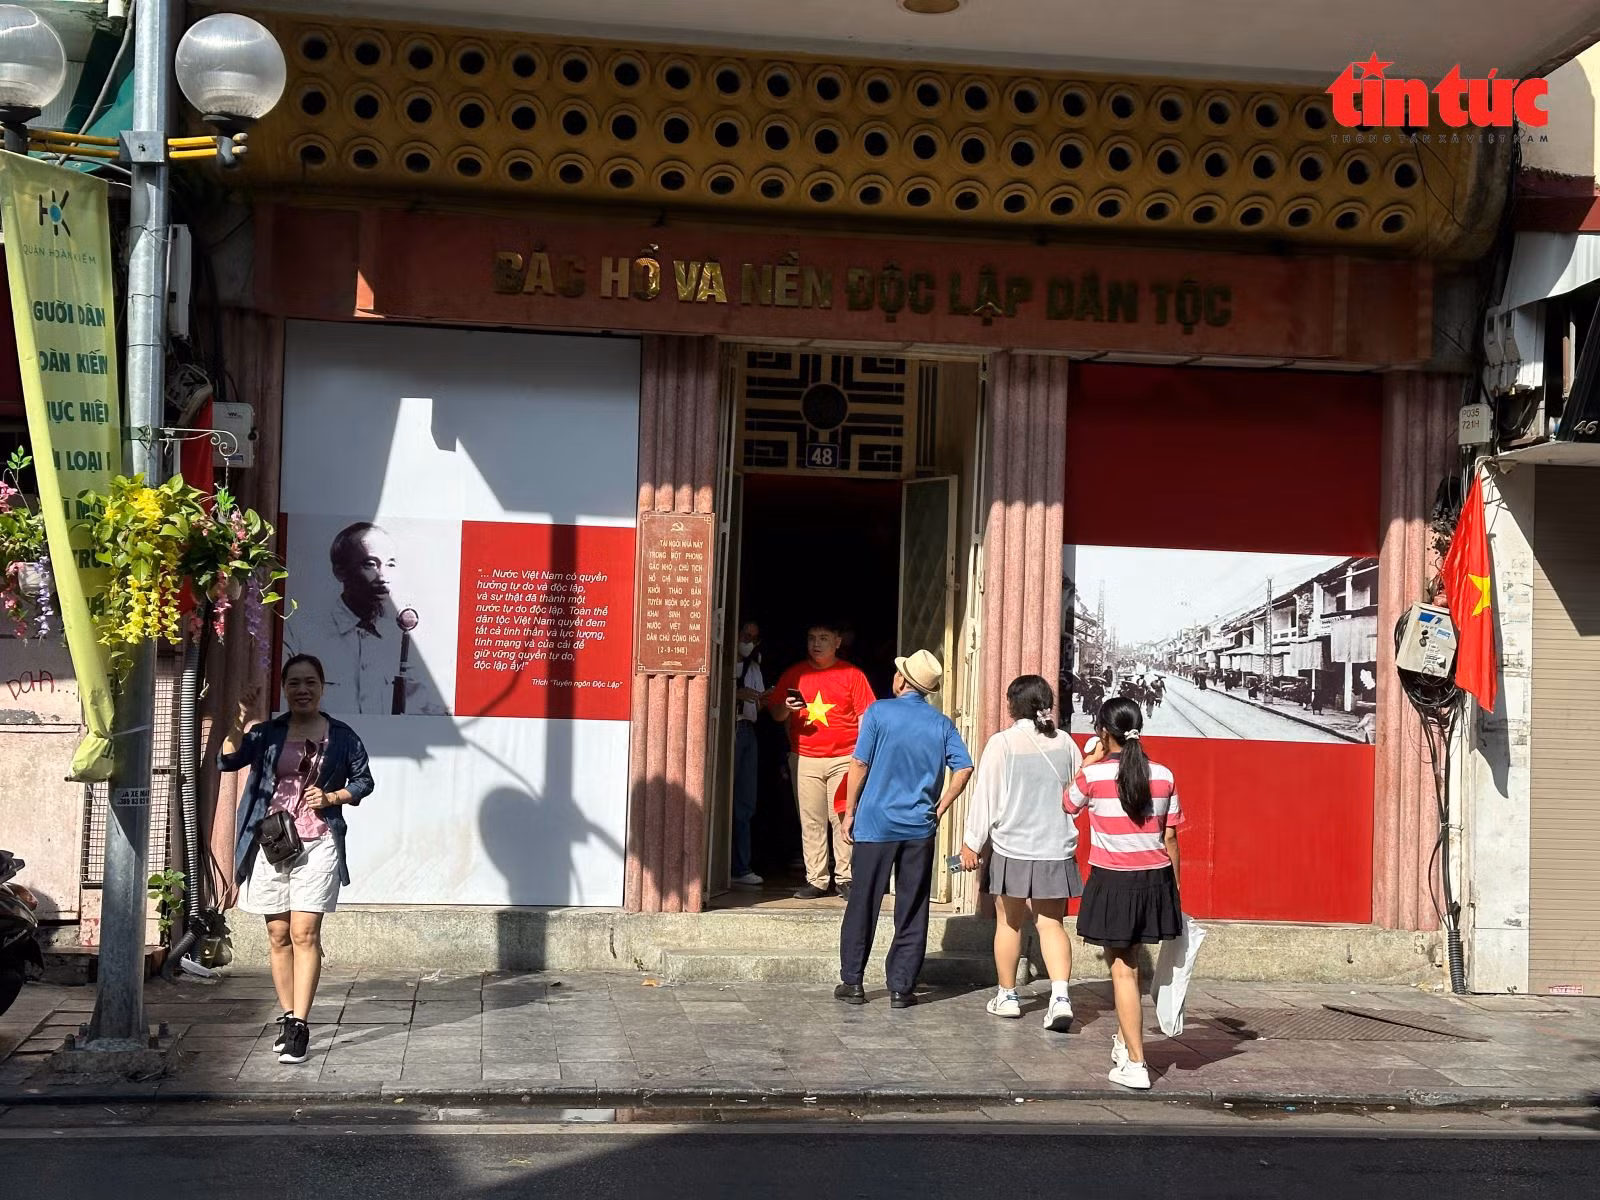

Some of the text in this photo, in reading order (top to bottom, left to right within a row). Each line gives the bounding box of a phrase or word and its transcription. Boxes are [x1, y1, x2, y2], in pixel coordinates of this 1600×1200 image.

[494, 242, 586, 297] BÁC
[600, 242, 662, 301] HỒ
[741, 250, 833, 309] NỀN
[1151, 273, 1233, 335] TỘC
[77, 302, 106, 327] DÂN
[1573, 420, 1599, 435] 46
[811, 448, 833, 465] 48
[649, 551, 667, 559] TRONG
[492, 568, 519, 579] Nước
[521, 569, 539, 581] Việt
[541, 570, 563, 580] Nam
[565, 572, 577, 581] có
[579, 571, 608, 584] quyền
[648, 572, 656, 582] HỒ
[676, 575, 689, 584] MINH
[476, 580, 586, 595] hưởng tự do và độc lập,
[476, 592, 586, 606] và sự thật đã thành một
[475, 603, 609, 616] nước tự do độc lập. Toàn thể
[689, 611, 701, 619] CHO
[475, 614, 606, 629] dân tộc Việt Nam quyết đem
[689, 623, 701, 631] NAM
[475, 624, 606, 641] tất cả tinh thần và lực lượng,
[494, 639, 522, 650] mạng
[524, 638, 535, 648] và
[537, 639, 555, 649] của
[557, 640, 571, 649] cải
[572, 638, 585, 650] để
[473, 648, 575, 662] giữ vững quyền tự do,
[473, 660, 491, 671] độc
[493, 661, 508, 672] lập
[531, 678, 548, 686] Trích
[573, 680, 591, 689] ngôn
[592, 680, 606, 689] Độc
